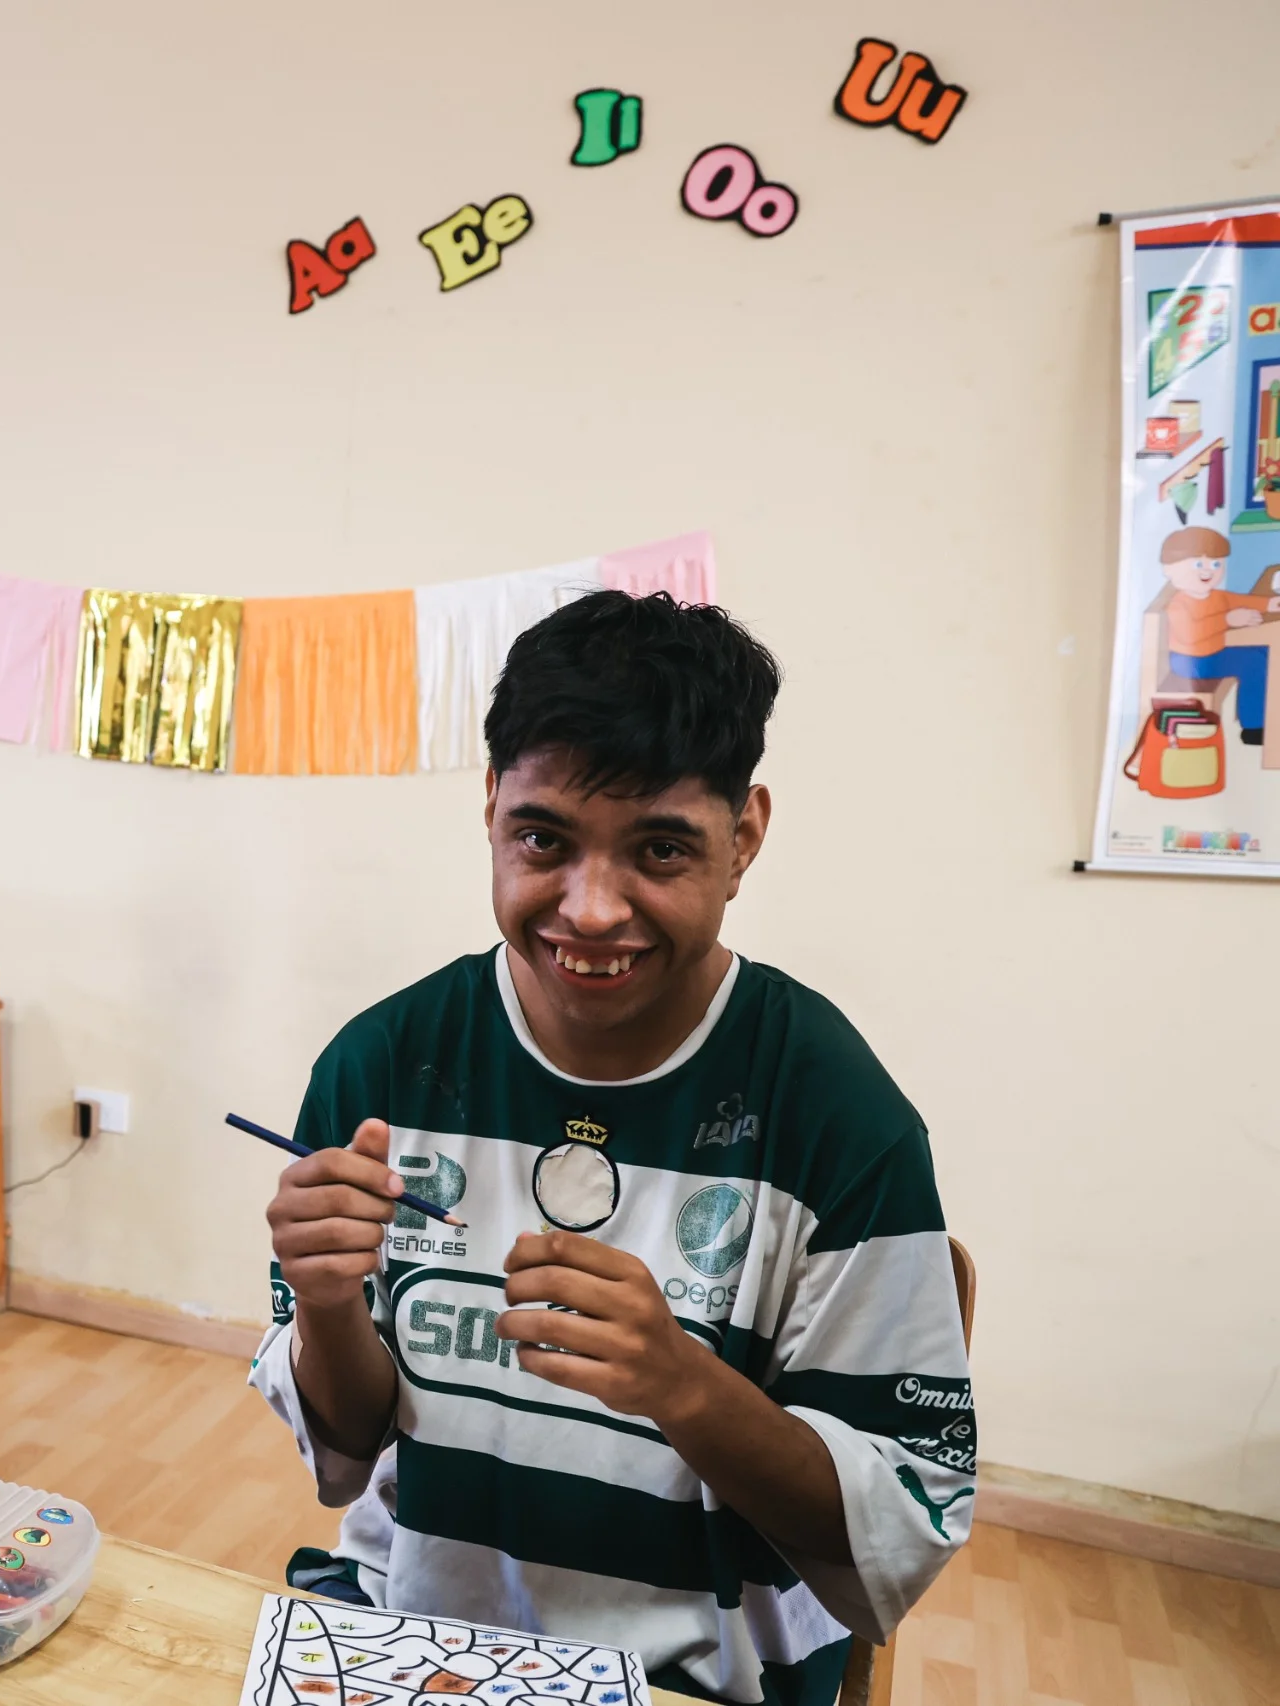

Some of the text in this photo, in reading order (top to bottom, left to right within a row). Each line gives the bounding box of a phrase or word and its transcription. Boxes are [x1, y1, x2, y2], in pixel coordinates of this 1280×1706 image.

[833, 37, 967, 144] Uu
[681, 143, 799, 238] Oo
[287, 215, 376, 315] Aa
[418, 193, 534, 292] Ee
[895, 1376, 976, 1410] Omni
[301, 1654, 316, 1662] 12
